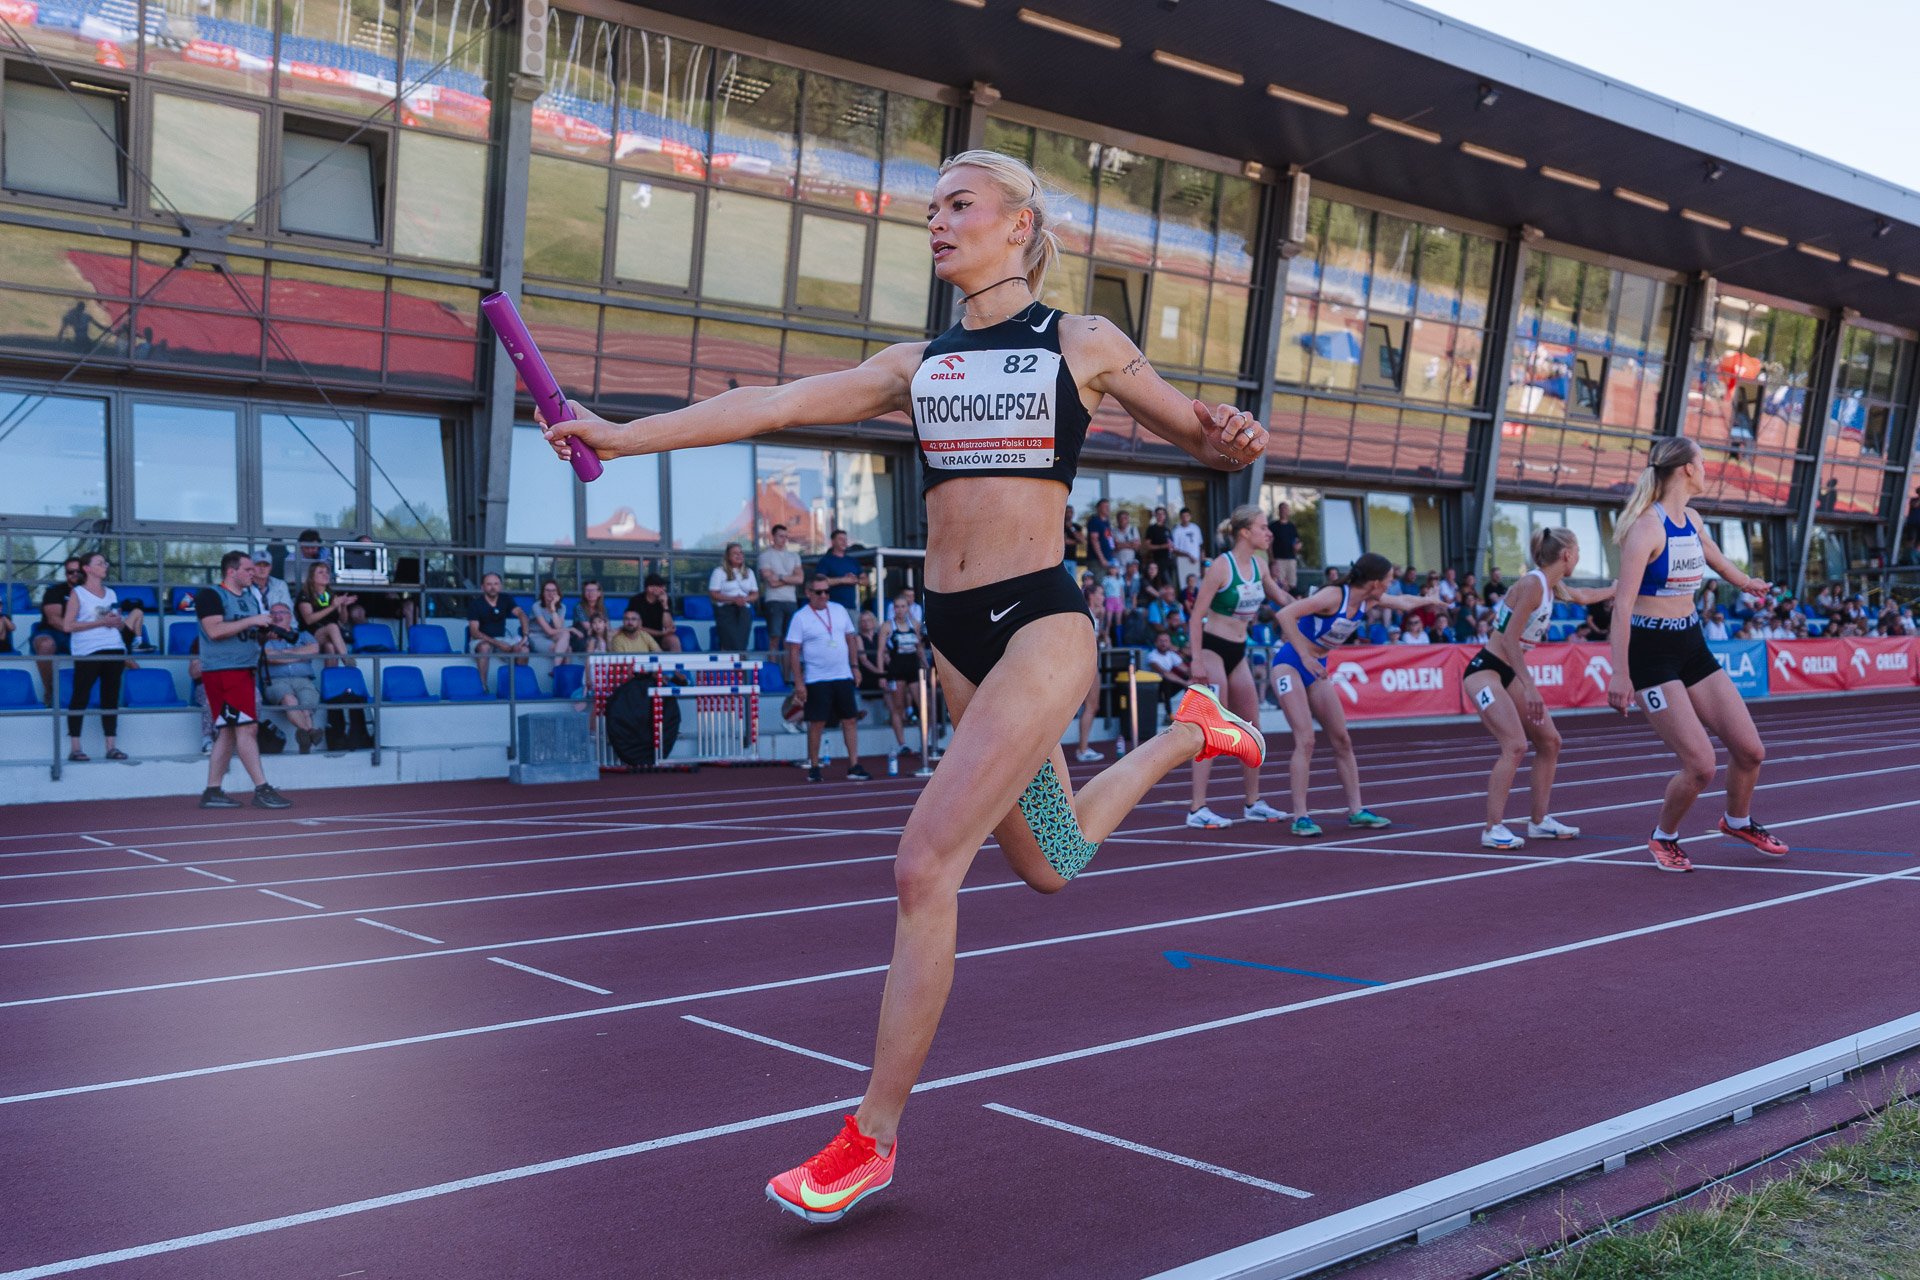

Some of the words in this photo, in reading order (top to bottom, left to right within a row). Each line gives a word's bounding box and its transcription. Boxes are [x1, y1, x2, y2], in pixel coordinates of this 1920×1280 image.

[1003, 354, 1039, 374] 82
[930, 372, 965, 381] ORLEN
[917, 392, 1050, 424] TROCHOLEPSZA
[938, 441, 956, 450] PZLA
[957, 440, 1000, 449] Mistrzostwa
[1001, 439, 1025, 448] Polski
[1026, 439, 1042, 447] U23
[941, 452, 993, 465] KRAKÓW
[995, 453, 1026, 464] 2025
[1631, 614, 1660, 629] NIKE
[1660, 617, 1687, 631] PRO
[1801, 655, 1838, 675] ORLEN
[1875, 652, 1908, 671] ORLEN
[1279, 677, 1288, 692] 5
[1381, 667, 1443, 692] ORLEN
[1527, 664, 1563, 686] LEN
[1481, 690, 1490, 705] 4
[1647, 690, 1661, 709] 6
